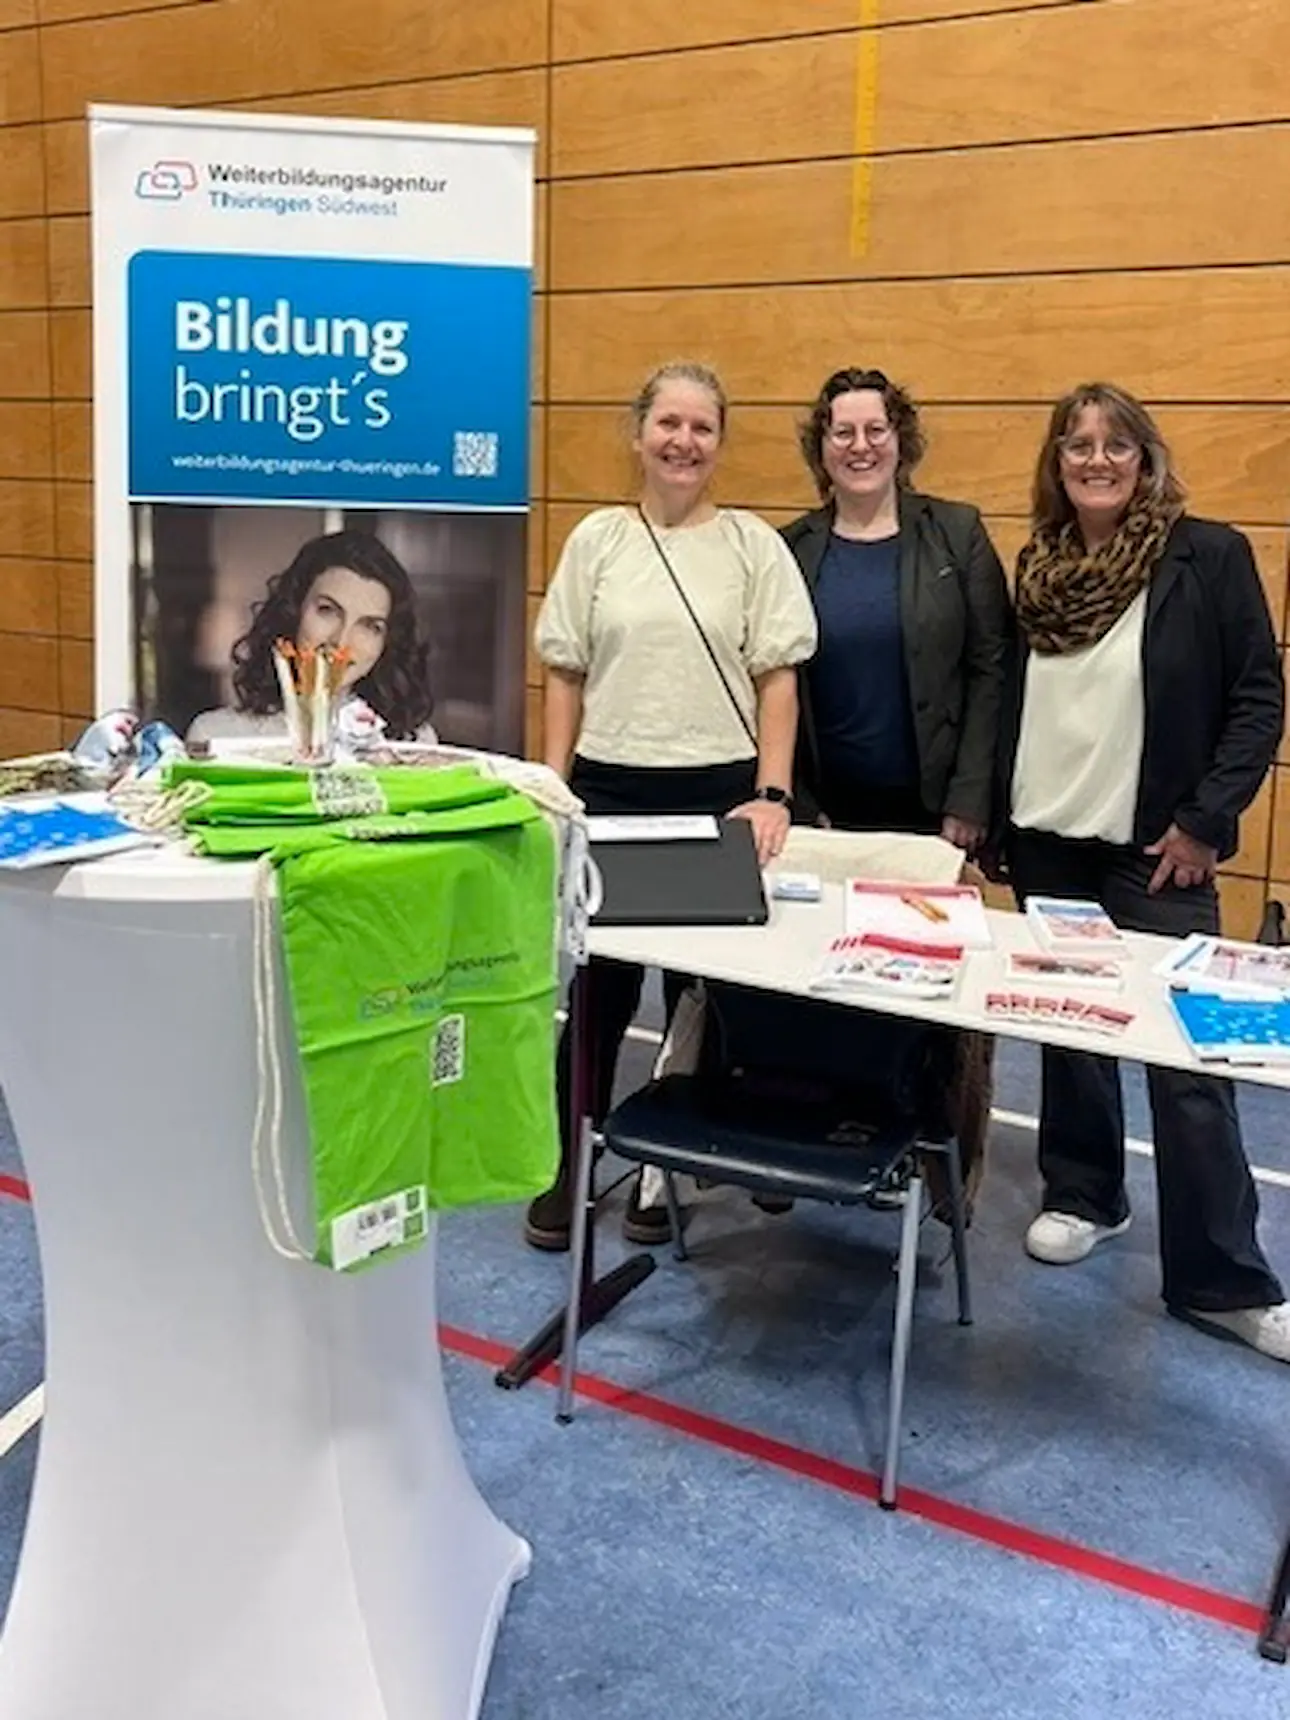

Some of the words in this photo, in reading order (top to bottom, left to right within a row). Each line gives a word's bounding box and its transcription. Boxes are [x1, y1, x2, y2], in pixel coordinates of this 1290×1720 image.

[207, 164, 447, 194] Weiterbildungsagentur
[208, 190, 312, 215] Thüringen
[317, 194, 397, 217] Südwest
[175, 297, 408, 374] Bildung
[171, 455, 441, 478] weiterbildungsagentur-thueringen.de
